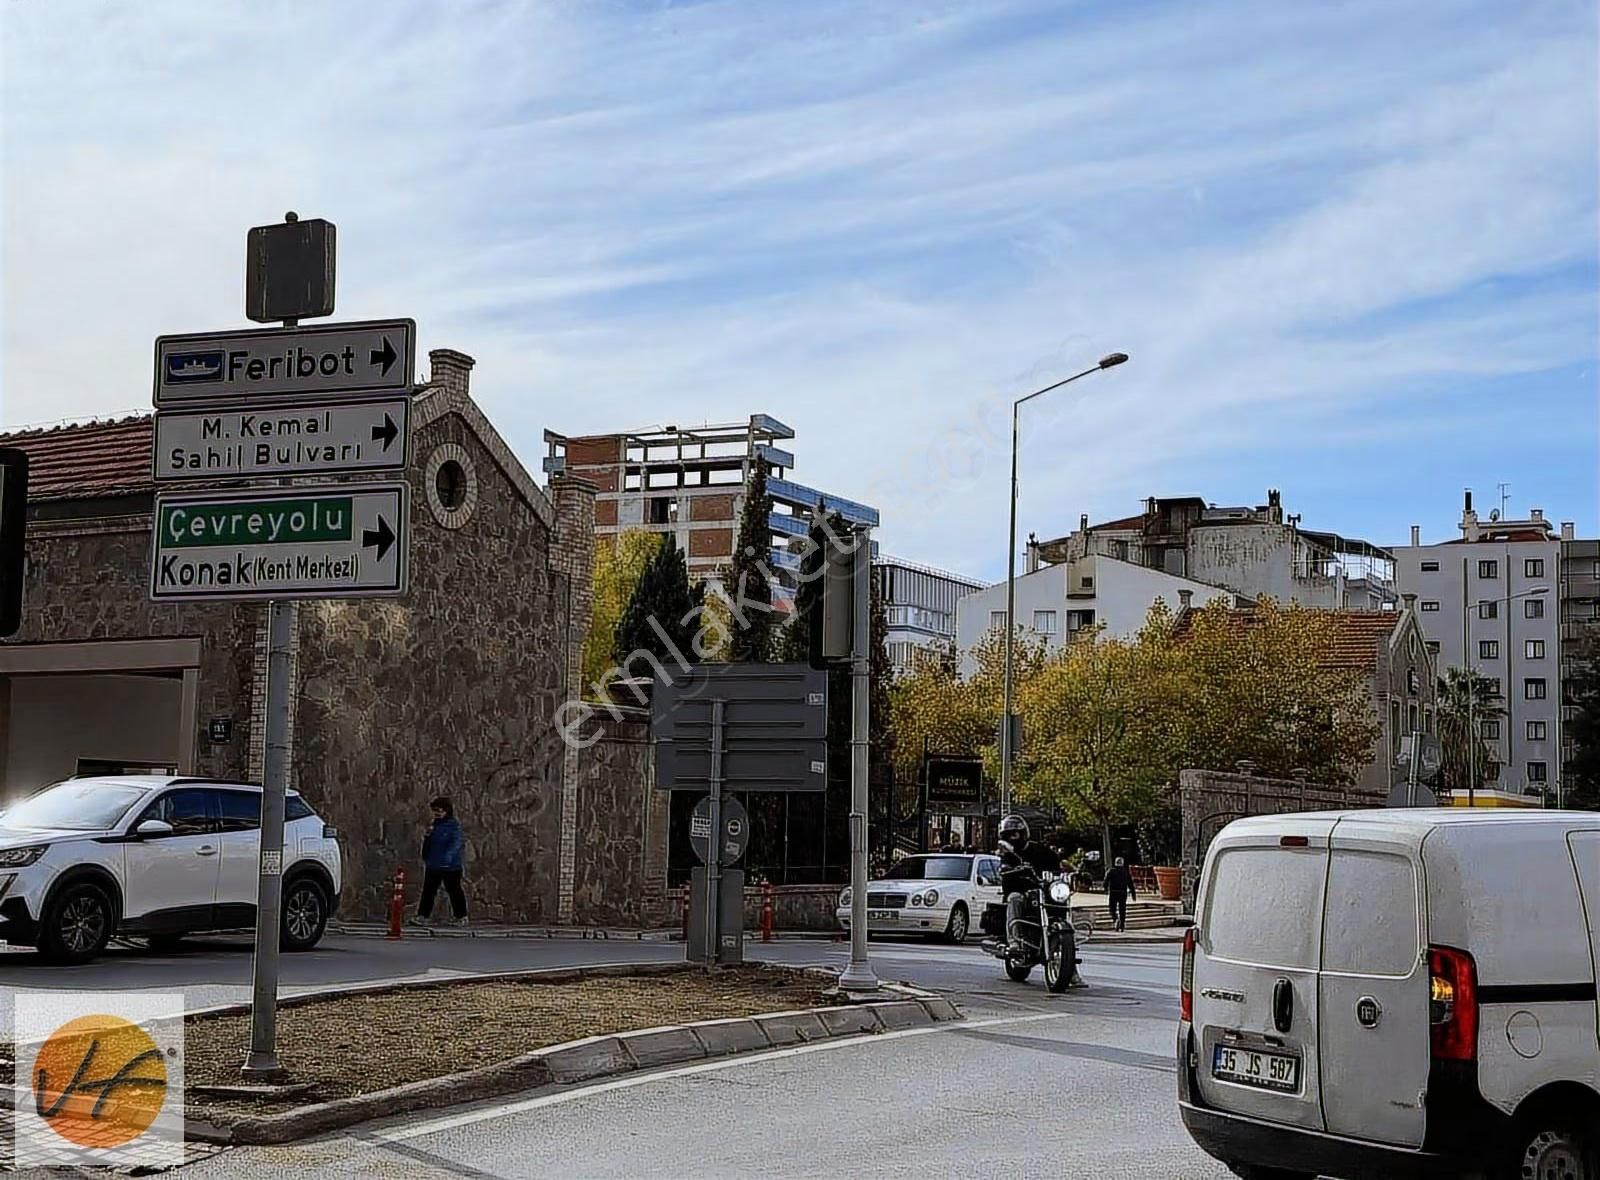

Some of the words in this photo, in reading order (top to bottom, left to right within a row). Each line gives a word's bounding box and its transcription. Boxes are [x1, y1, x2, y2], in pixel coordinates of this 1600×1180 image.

[228, 345, 355, 382] Feribot
[202, 417, 231, 440] M.
[240, 411, 331, 438] Kemal
[171, 444, 242, 470] Sahil
[255, 441, 362, 465] Bulvarı
[169, 502, 343, 542] Çevreyolu
[160, 552, 251, 586] Konak
[252, 556, 292, 585] (Kent
[296, 552, 360, 583] Merkezi)
[1221, 1049, 1237, 1071] 35
[1246, 1052, 1262, 1075] JS
